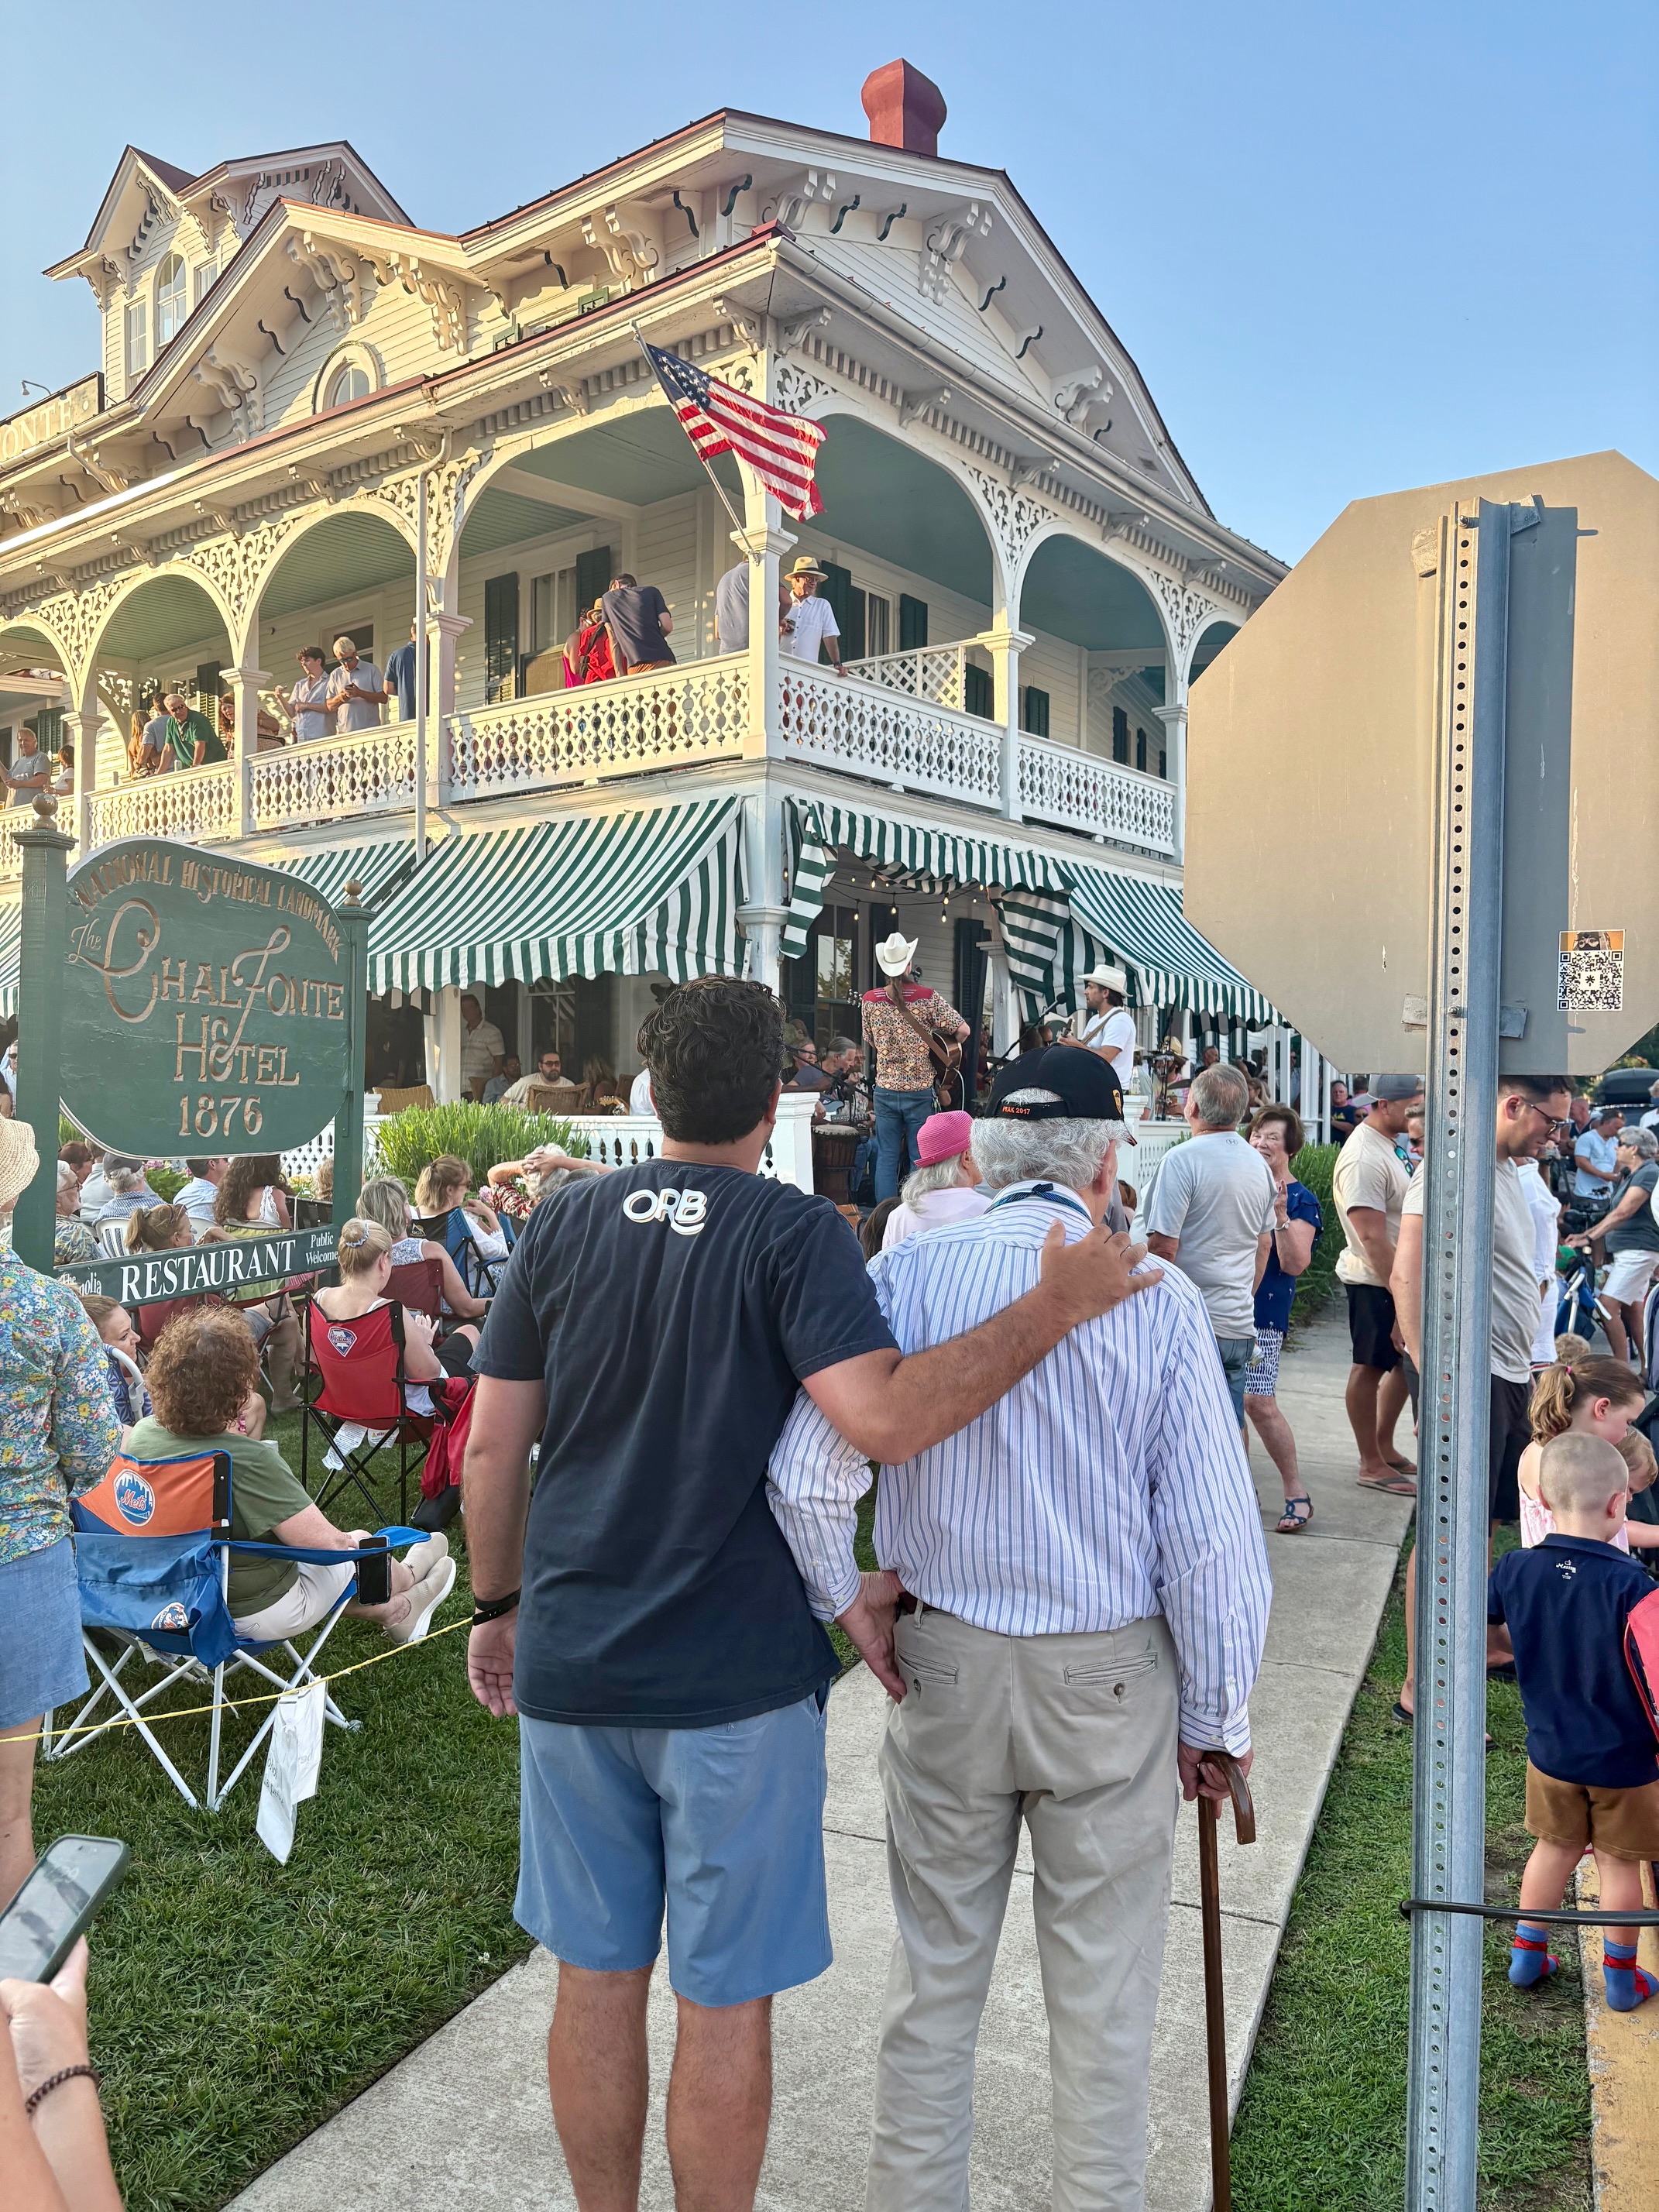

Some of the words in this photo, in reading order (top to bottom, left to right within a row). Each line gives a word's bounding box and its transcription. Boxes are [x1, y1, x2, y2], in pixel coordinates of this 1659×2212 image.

[75, 851, 173, 918] NATIONAL
[180, 859, 271, 904] HISTORICAL
[277, 884, 345, 965] LANDMARK
[70, 917, 101, 955] The
[173, 1011, 300, 1086] HOTEL
[178, 1093, 263, 1138] 1876
[623, 1188, 708, 1235] ORB
[305, 1250, 338, 1265] Welcome
[311, 1231, 334, 1249] Public
[119, 1239, 297, 1304] RESTAURANT
[120, 1489, 147, 1512] Mets
